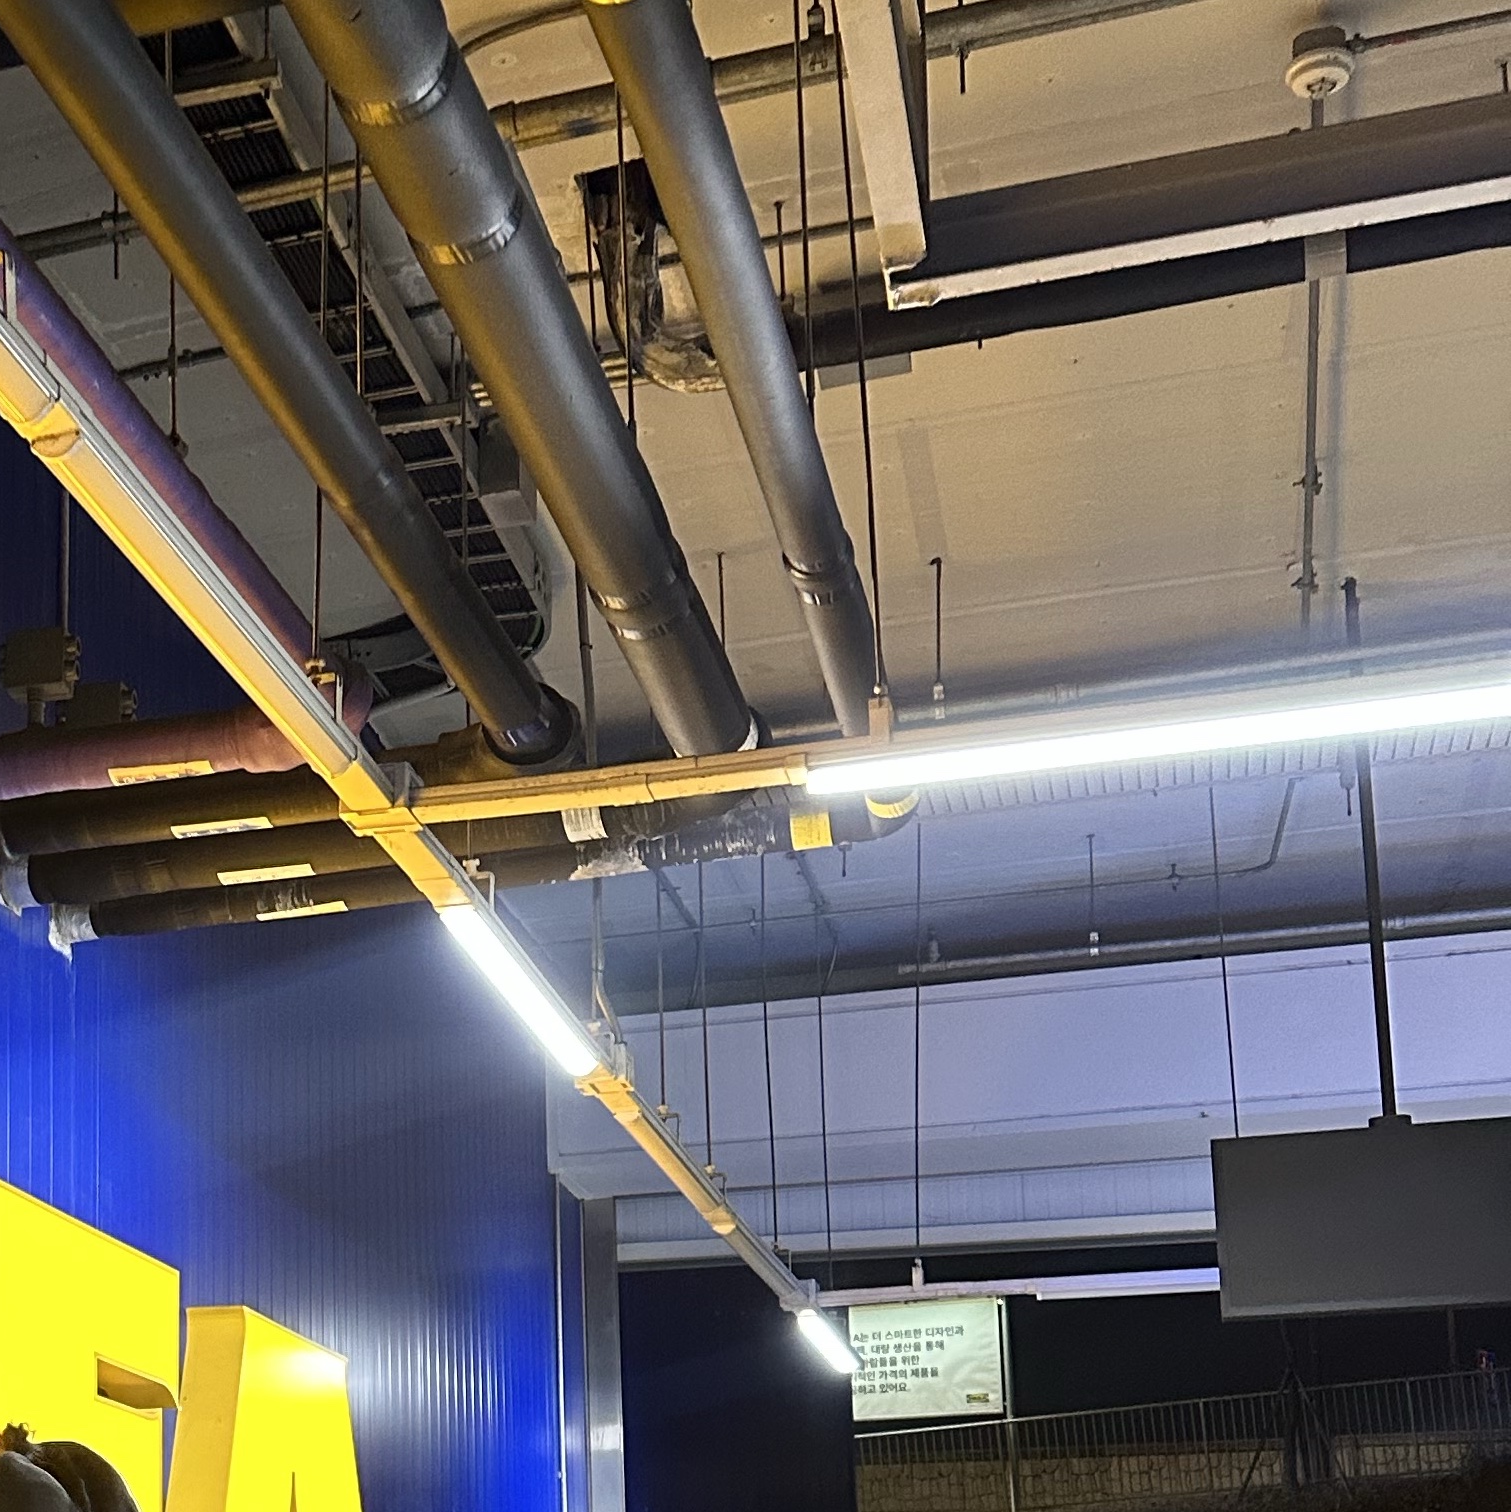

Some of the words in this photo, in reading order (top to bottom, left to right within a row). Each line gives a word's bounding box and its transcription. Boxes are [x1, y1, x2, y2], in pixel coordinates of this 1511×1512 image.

[872, 1331, 881, 1341] 더
[885, 1328, 922, 1340] 스마트한
[925, 1325, 964, 1337] 디자인과
[870, 1344, 890, 1354] 대량
[893, 1342, 922, 1353] 생산을
[925, 1340, 945, 1351] 통해
[901, 1355, 920, 1366] 위한
[878, 1369, 908, 1380] 가격의
[910, 1367, 939, 1378] 제품을
